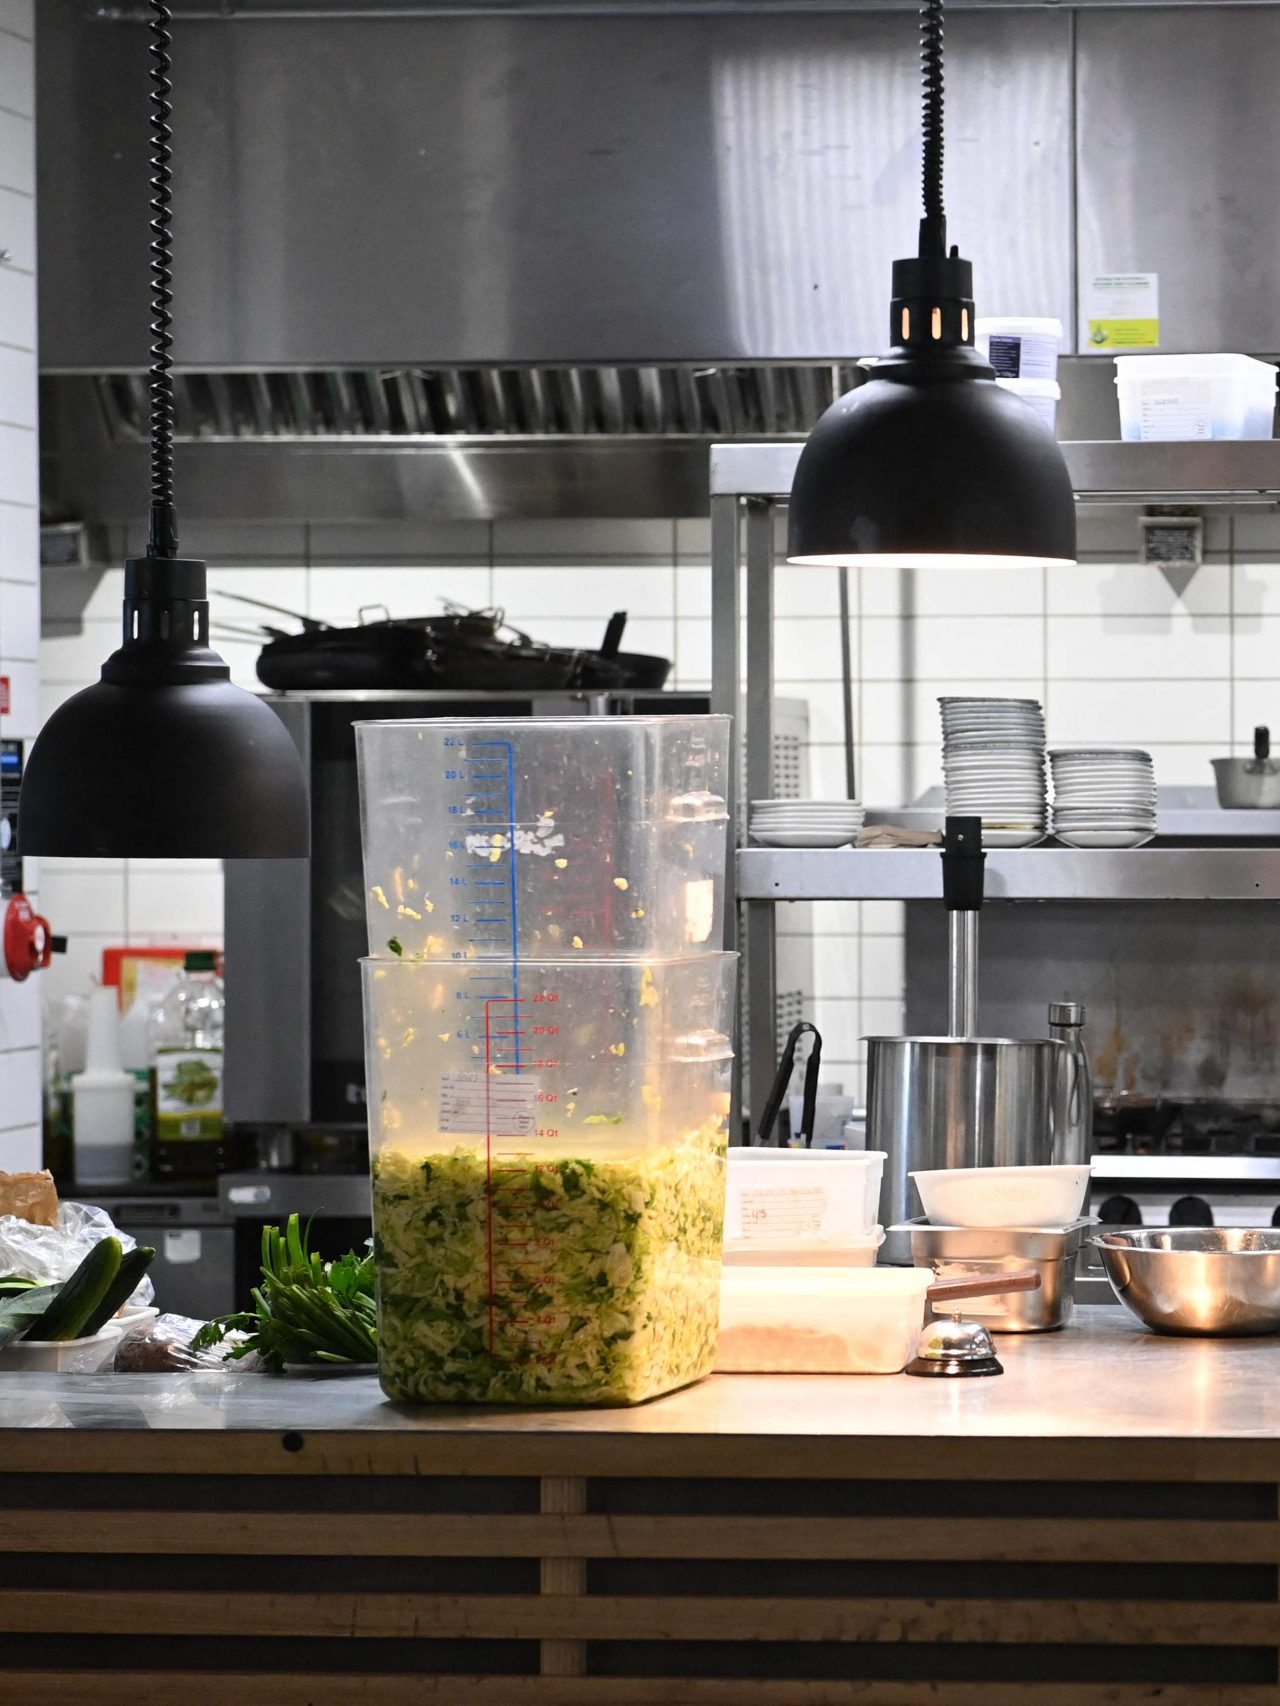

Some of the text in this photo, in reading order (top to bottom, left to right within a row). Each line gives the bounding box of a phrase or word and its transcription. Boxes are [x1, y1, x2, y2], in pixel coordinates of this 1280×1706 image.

[444, 738, 455, 746] 22
[445, 771, 456, 779] 20
[451, 914, 460, 922] 12
[534, 1129, 558, 1137] 14 Qt
